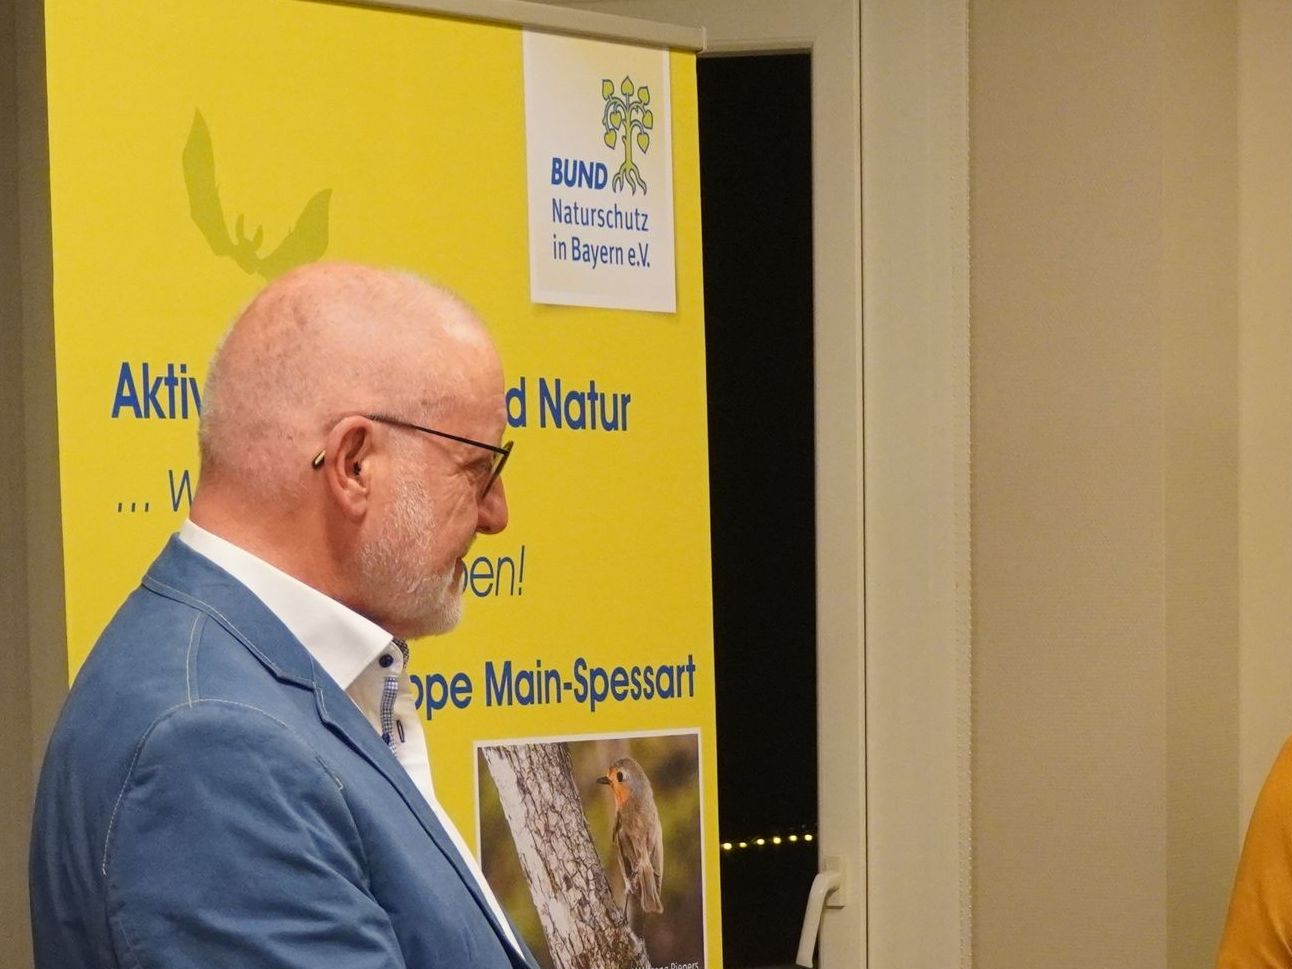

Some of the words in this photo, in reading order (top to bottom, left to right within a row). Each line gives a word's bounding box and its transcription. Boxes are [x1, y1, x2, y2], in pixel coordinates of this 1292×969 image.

[551, 157, 608, 190] BUND
[552, 198, 649, 231] Naturschutz
[553, 234, 567, 260] in
[571, 236, 624, 270] Bayern
[627, 242, 651, 268] e.V.
[539, 377, 631, 431] Natur
[485, 654, 697, 712] Main-Spessart
